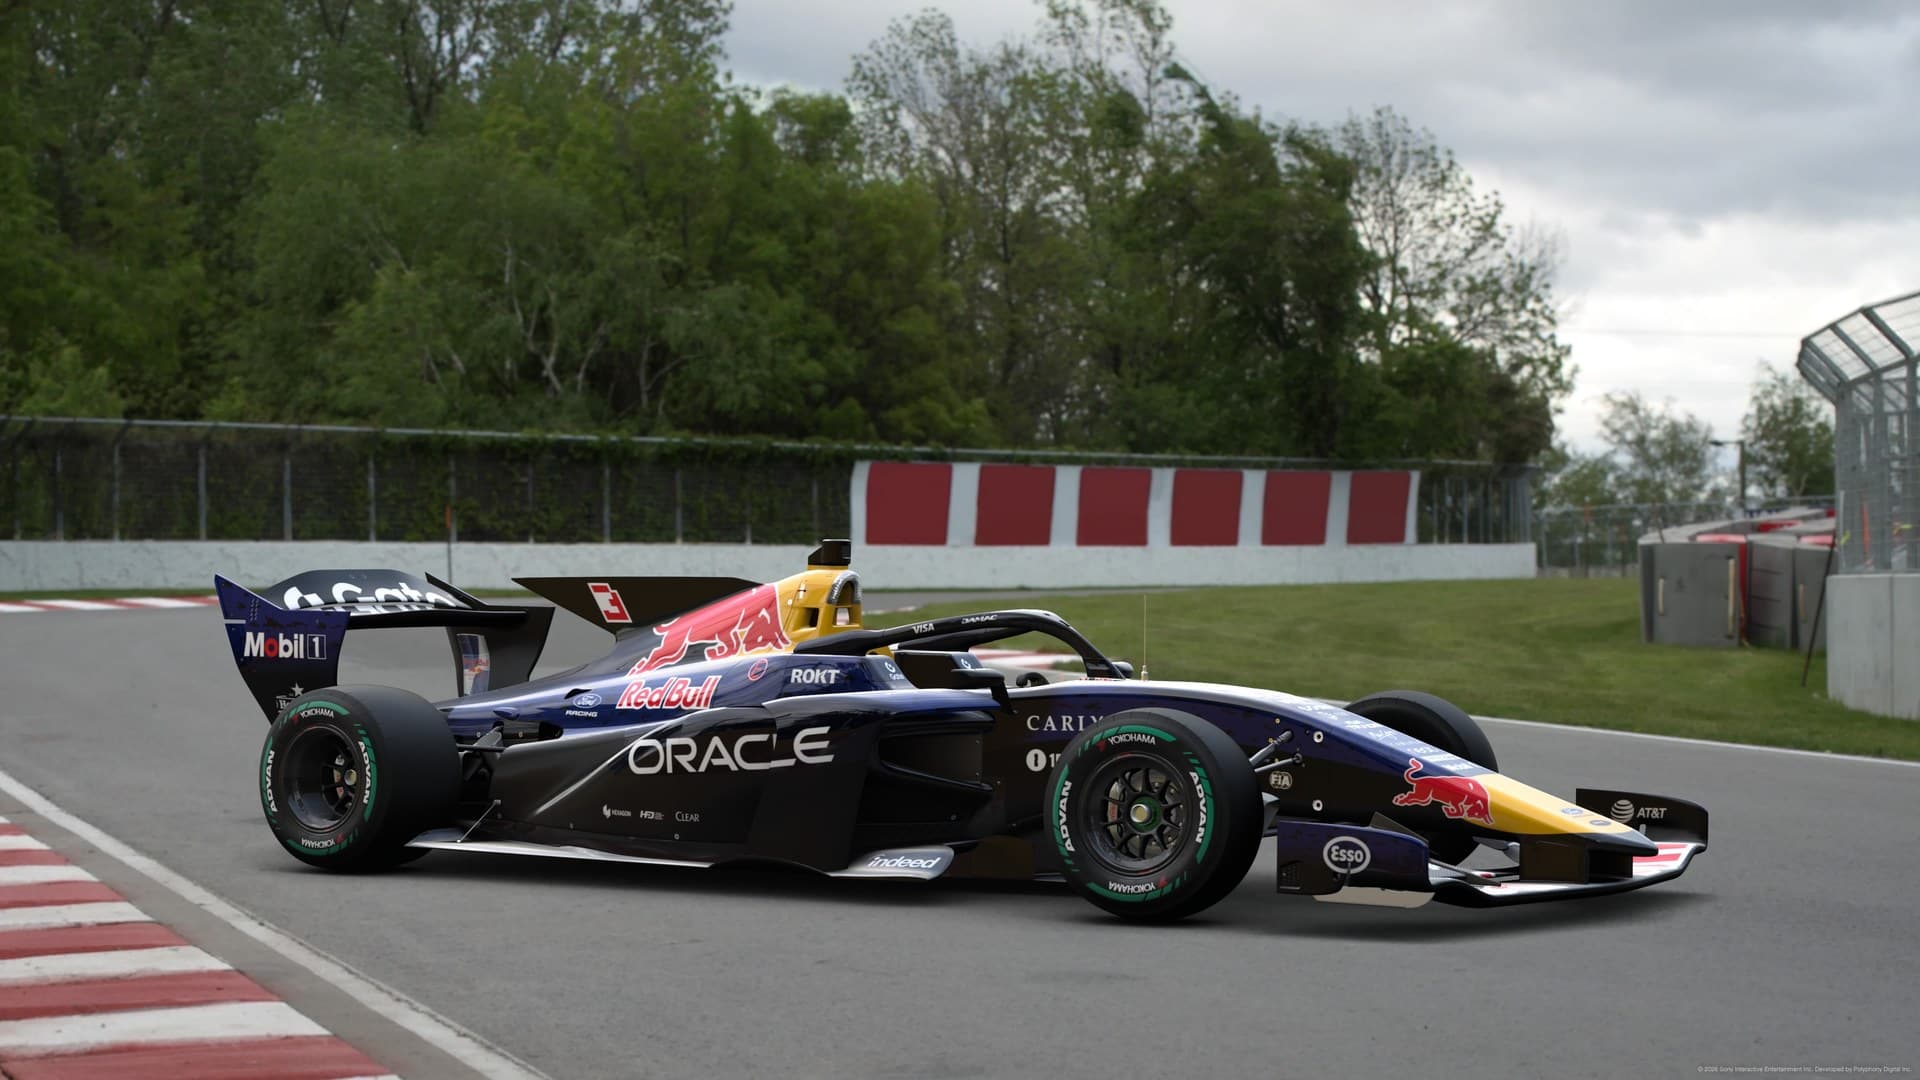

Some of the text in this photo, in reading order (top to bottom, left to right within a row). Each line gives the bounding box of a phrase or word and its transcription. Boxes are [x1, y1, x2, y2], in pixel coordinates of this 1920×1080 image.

[587, 582, 632, 623] 3
[961, 615, 998, 624] DAMAC
[912, 623, 935, 634] VISA
[244, 632, 322, 659] Mobil 1
[790, 668, 840, 684] ROKT
[616, 675, 722, 709] Red Bull
[300, 708, 334, 719] YOKOHAMA
[565, 709, 598, 719] RACING
[1108, 733, 1156, 745] YOKOHAMA
[628, 726, 834, 775] ORACLE
[358, 741, 371, 804] ADVAN
[1271, 773, 1290, 786] FIA
[265, 750, 278, 812] ADVAN
[1190, 772, 1206, 843] ADVAN
[1636, 807, 1667, 819] AT&T
[1058, 781, 1075, 852] ADVAN
[301, 837, 336, 849] YOKOHAMA
[1330, 845, 1364, 863] Esso
[868, 855, 941, 868] indeed
[1109, 881, 1156, 894] YOKOHAMA
